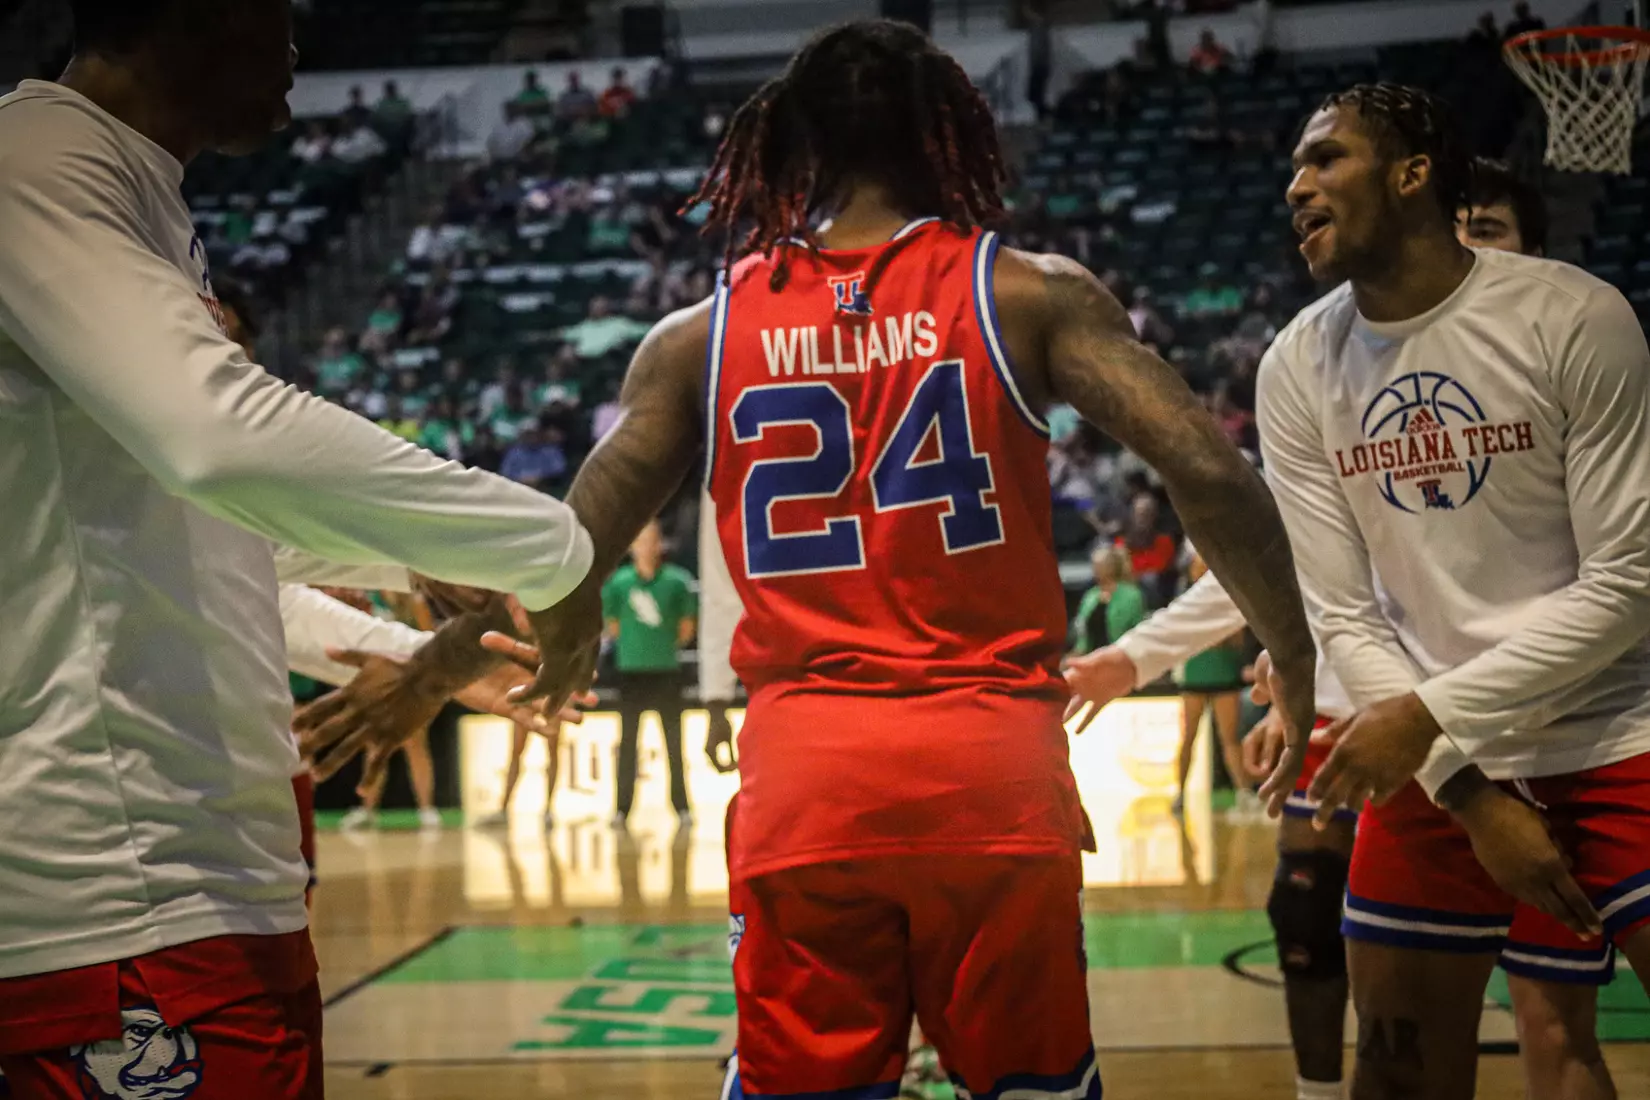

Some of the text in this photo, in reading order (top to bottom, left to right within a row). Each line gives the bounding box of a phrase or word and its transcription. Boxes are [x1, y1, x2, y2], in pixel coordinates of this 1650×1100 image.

[761, 310, 938, 377] WILLIAMS
[1462, 421, 1535, 457] TECH
[729, 358, 1005, 579] 24
[1393, 461, 1466, 481] BASKETBALL
